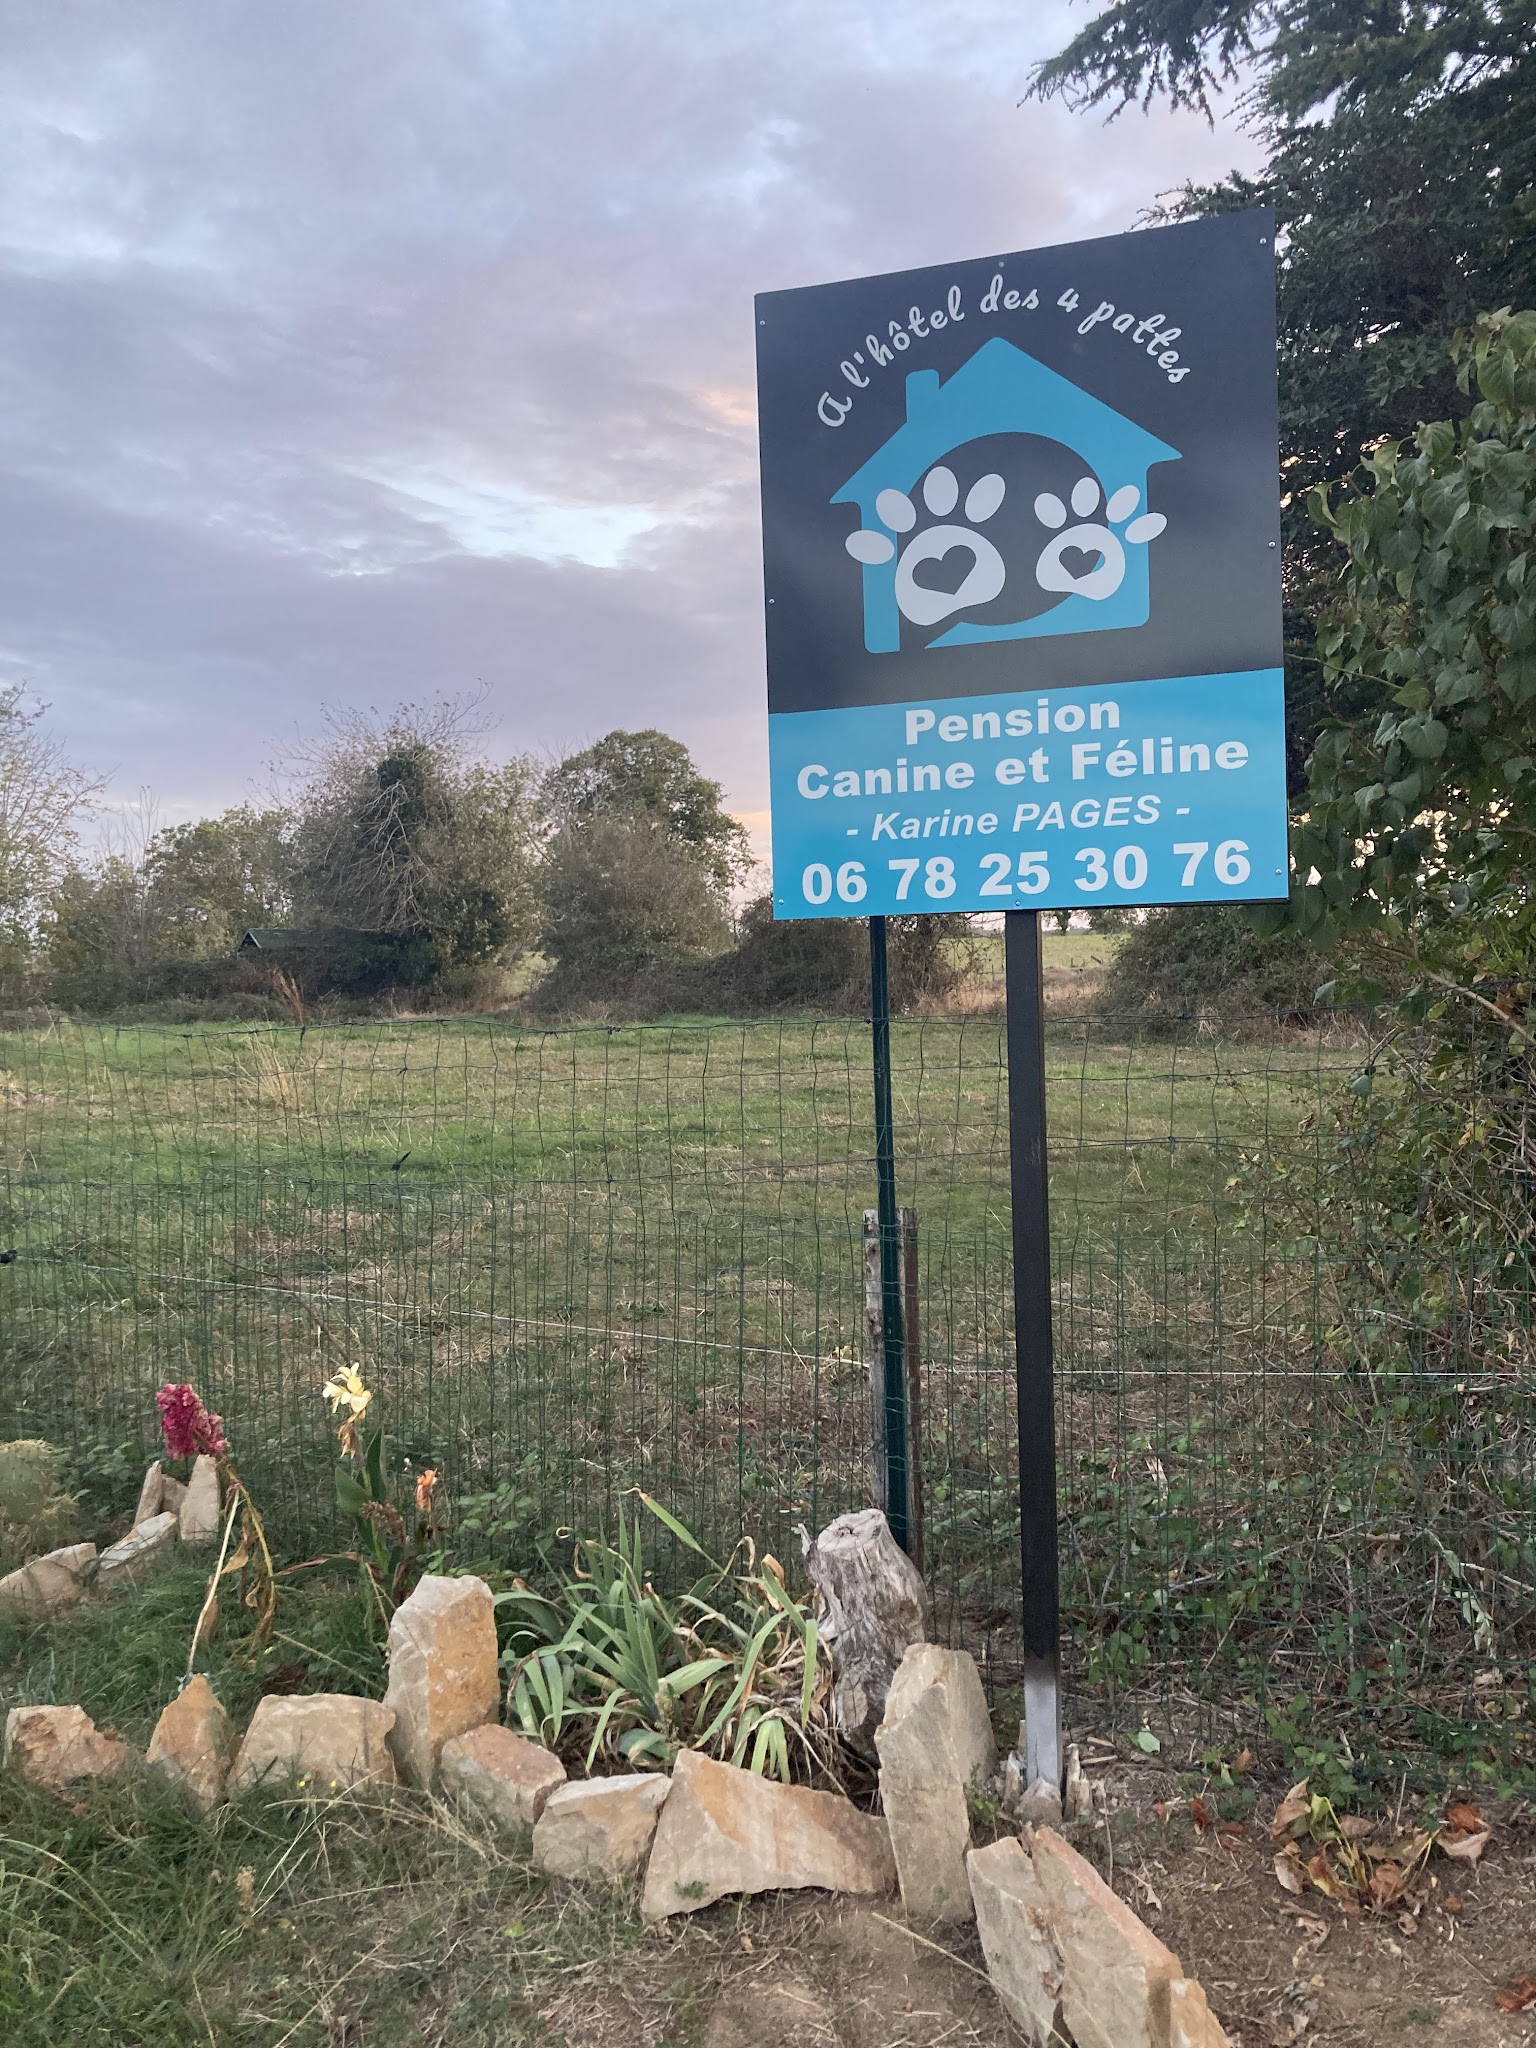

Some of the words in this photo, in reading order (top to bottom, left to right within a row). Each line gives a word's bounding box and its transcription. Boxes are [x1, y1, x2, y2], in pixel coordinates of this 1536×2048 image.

[840, 284, 965, 389] l'hôtel
[979, 273, 1039, 313] des
[1056, 287, 1080, 314] 4
[1077, 300, 1191, 384] pattes
[904, 697, 1121, 746] Pension
[796, 757, 976, 800] Canine
[994, 746, 1051, 786] et
[1071, 736, 1250, 781] Féline
[871, 808, 999, 842] Karine
[1012, 794, 1162, 833] PAGES
[802, 860, 868, 906] 06
[887, 855, 957, 901] 78
[979, 849, 1051, 897] 25
[1074, 845, 1149, 892] 30
[1172, 838, 1252, 888] 76
